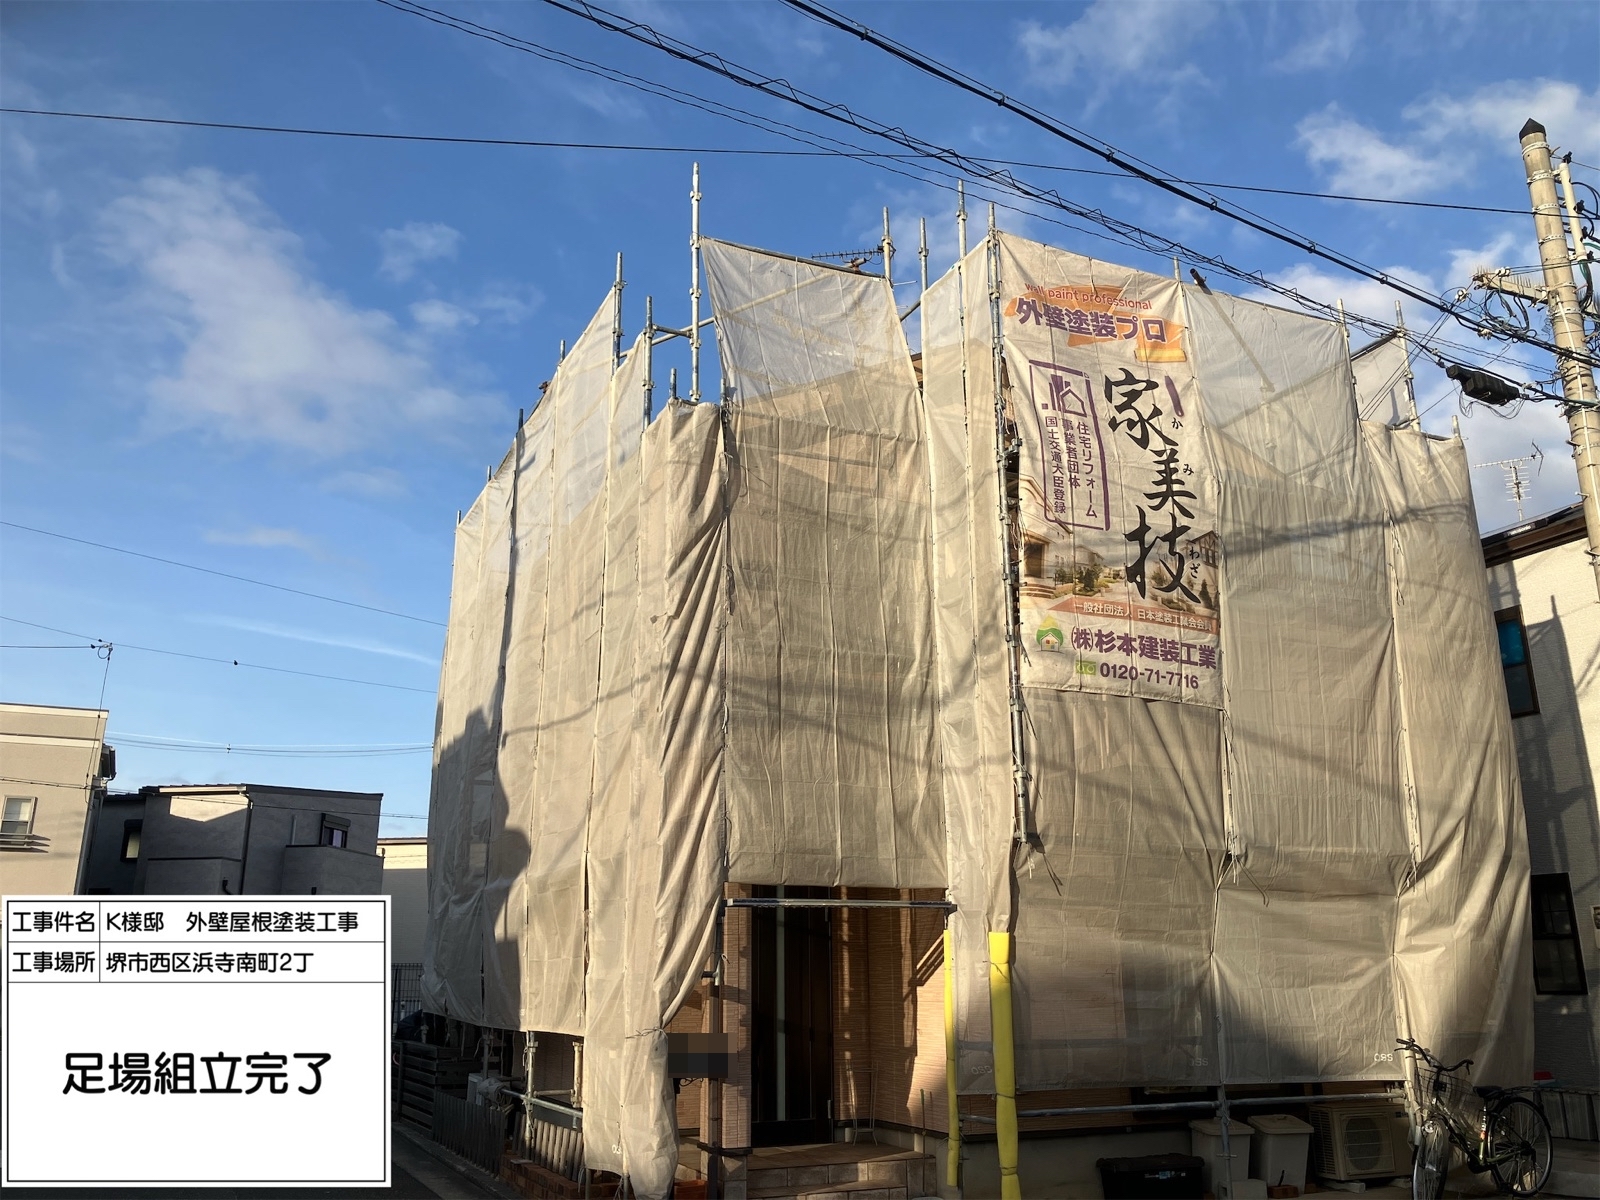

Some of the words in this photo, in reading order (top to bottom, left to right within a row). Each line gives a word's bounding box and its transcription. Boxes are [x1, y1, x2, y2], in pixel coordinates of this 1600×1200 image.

[1015, 297, 1167, 343] 外壁塗装プロ
[1048, 288, 1079, 301] paint
[1082, 293, 1153, 310] professional
[1045, 415, 1066, 514] 国土交通大臣登録
[1061, 417, 1081, 489] 事業者団体
[1076, 421, 1098, 518] 住宅リフォーム
[1104, 367, 1201, 604] 家美技
[1073, 601, 1133, 618] 一般社団法人
[1071, 625, 1217, 670] (株)杉本建装工業
[1099, 662, 1199, 690] 0120-71-7716
